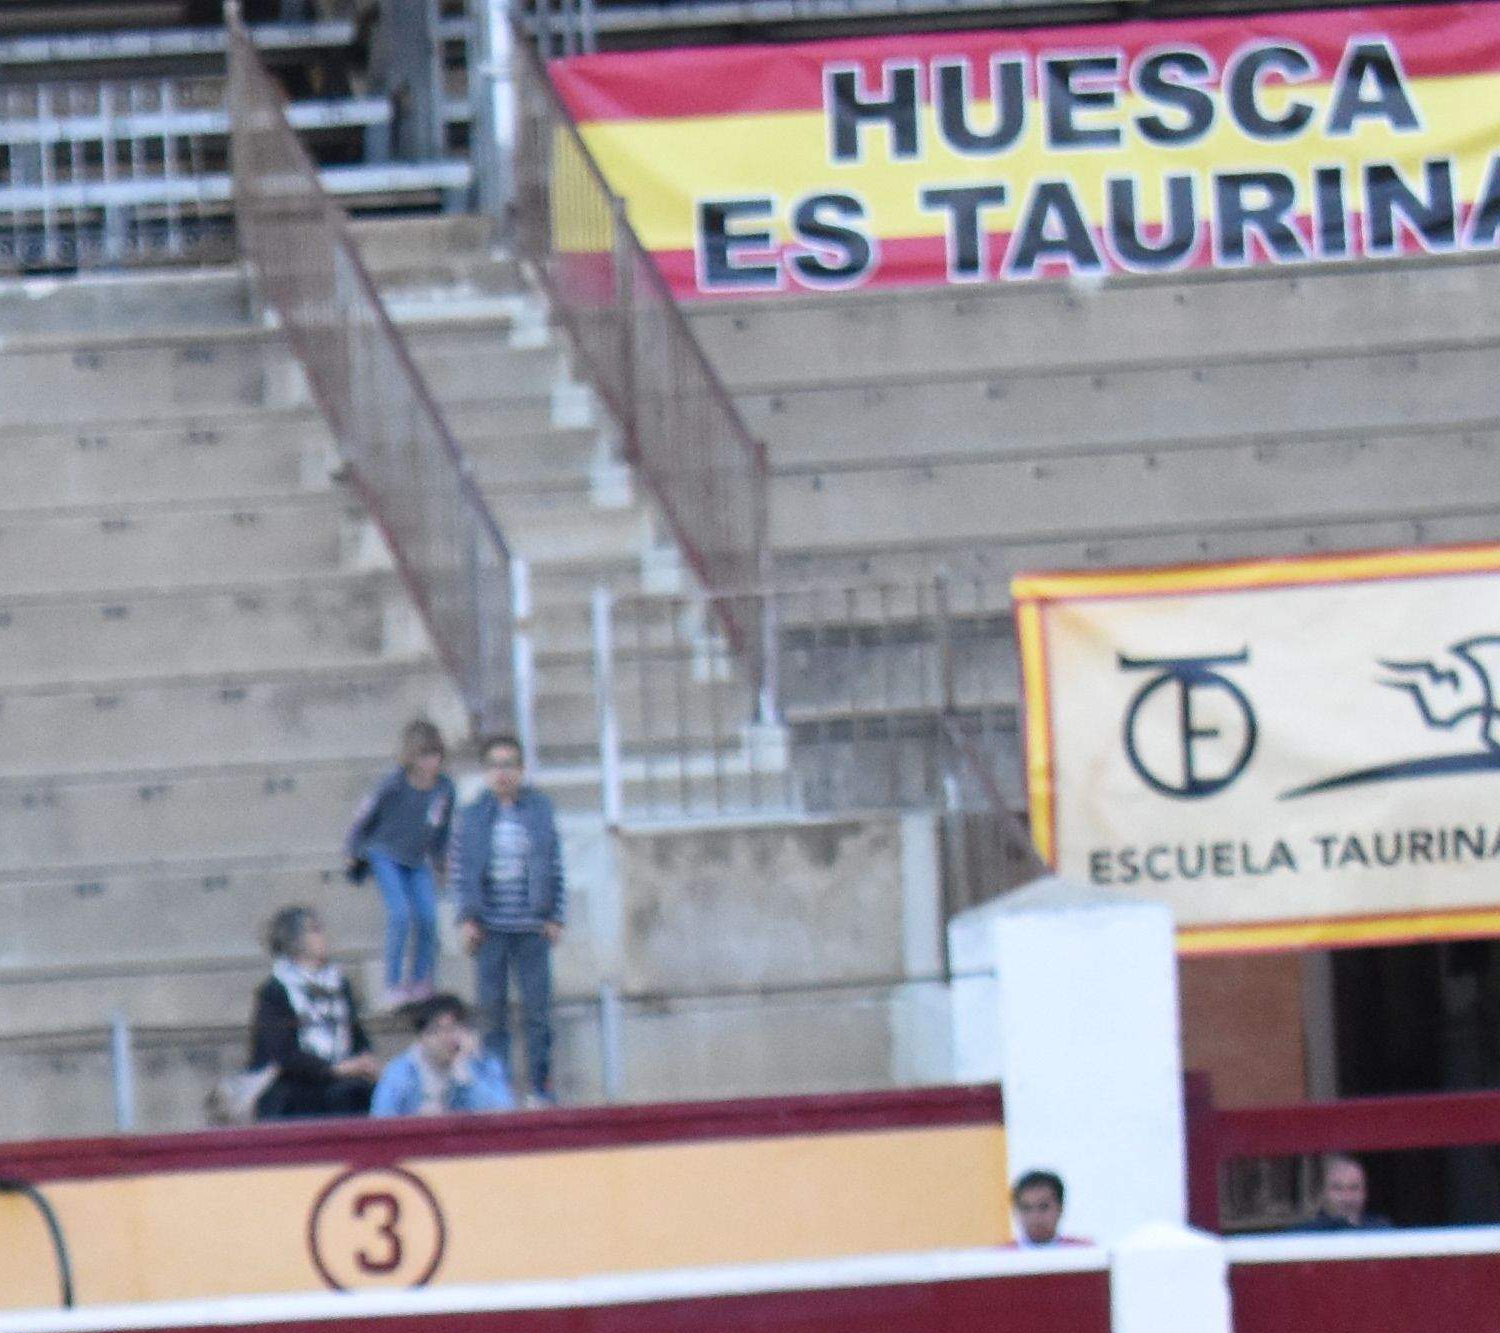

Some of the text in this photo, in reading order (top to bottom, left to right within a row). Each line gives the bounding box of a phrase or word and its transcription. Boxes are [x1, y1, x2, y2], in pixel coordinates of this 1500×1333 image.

[824, 36, 1422, 165] HUESCA
[696, 192, 878, 290] ES
[1089, 839, 1298, 886] ESCUELA
[353, 1191, 402, 1276] 3
